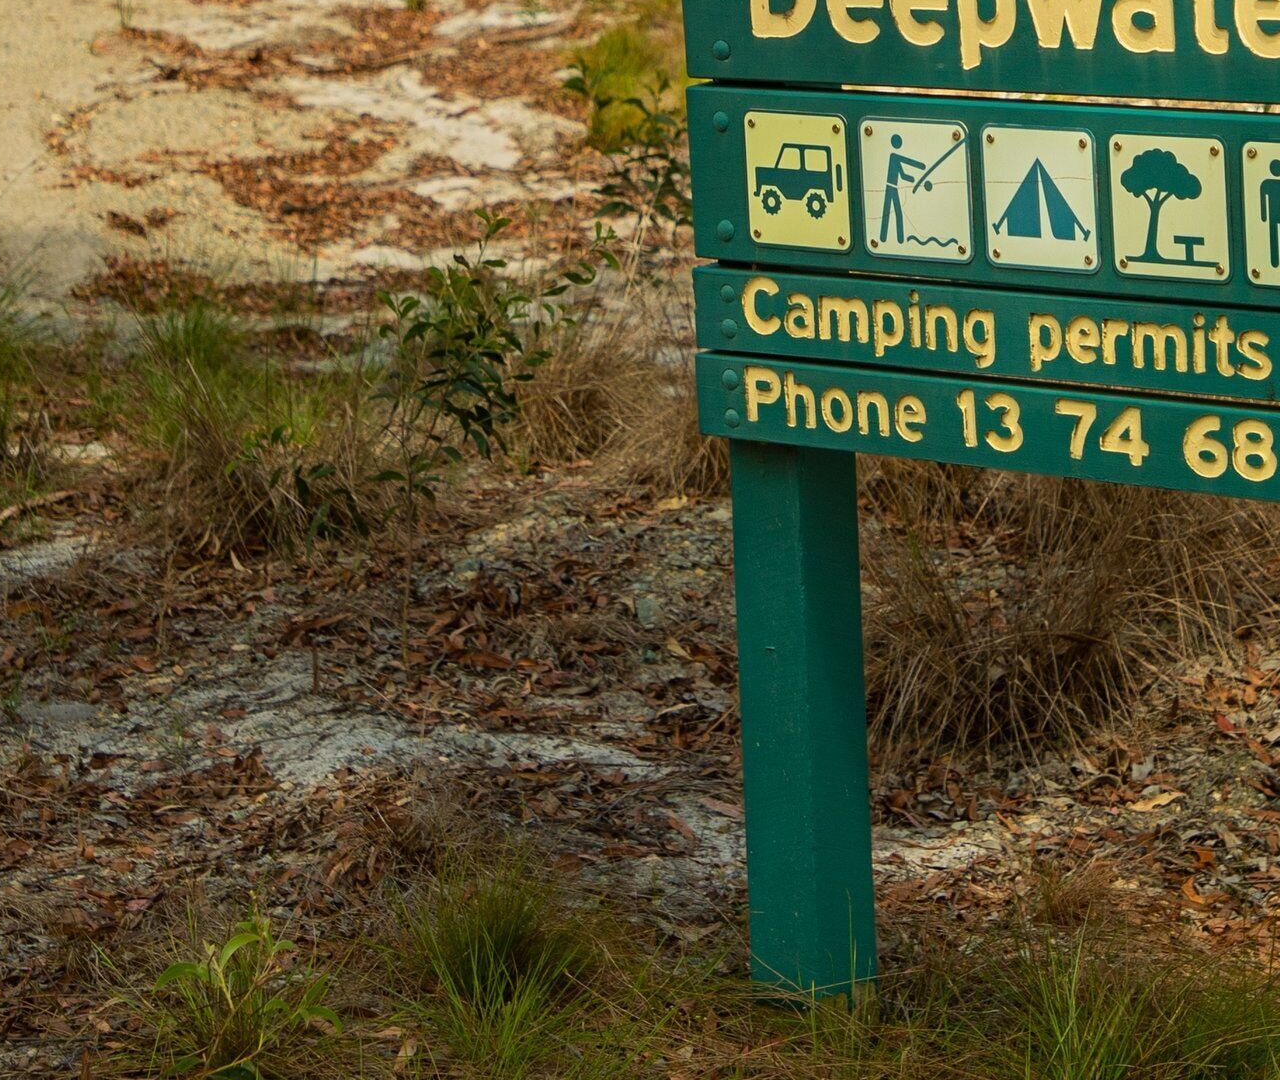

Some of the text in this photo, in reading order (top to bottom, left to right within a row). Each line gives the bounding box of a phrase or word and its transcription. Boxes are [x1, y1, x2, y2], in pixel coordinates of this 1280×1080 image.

[741, 277, 996, 368] Camping
[1028, 314, 1273, 381] permits
[743, 366, 927, 443] Phone
[956, 389, 1024, 453] 13
[1055, 399, 1149, 467] 74
[1183, 415, 1278, 482] 68
